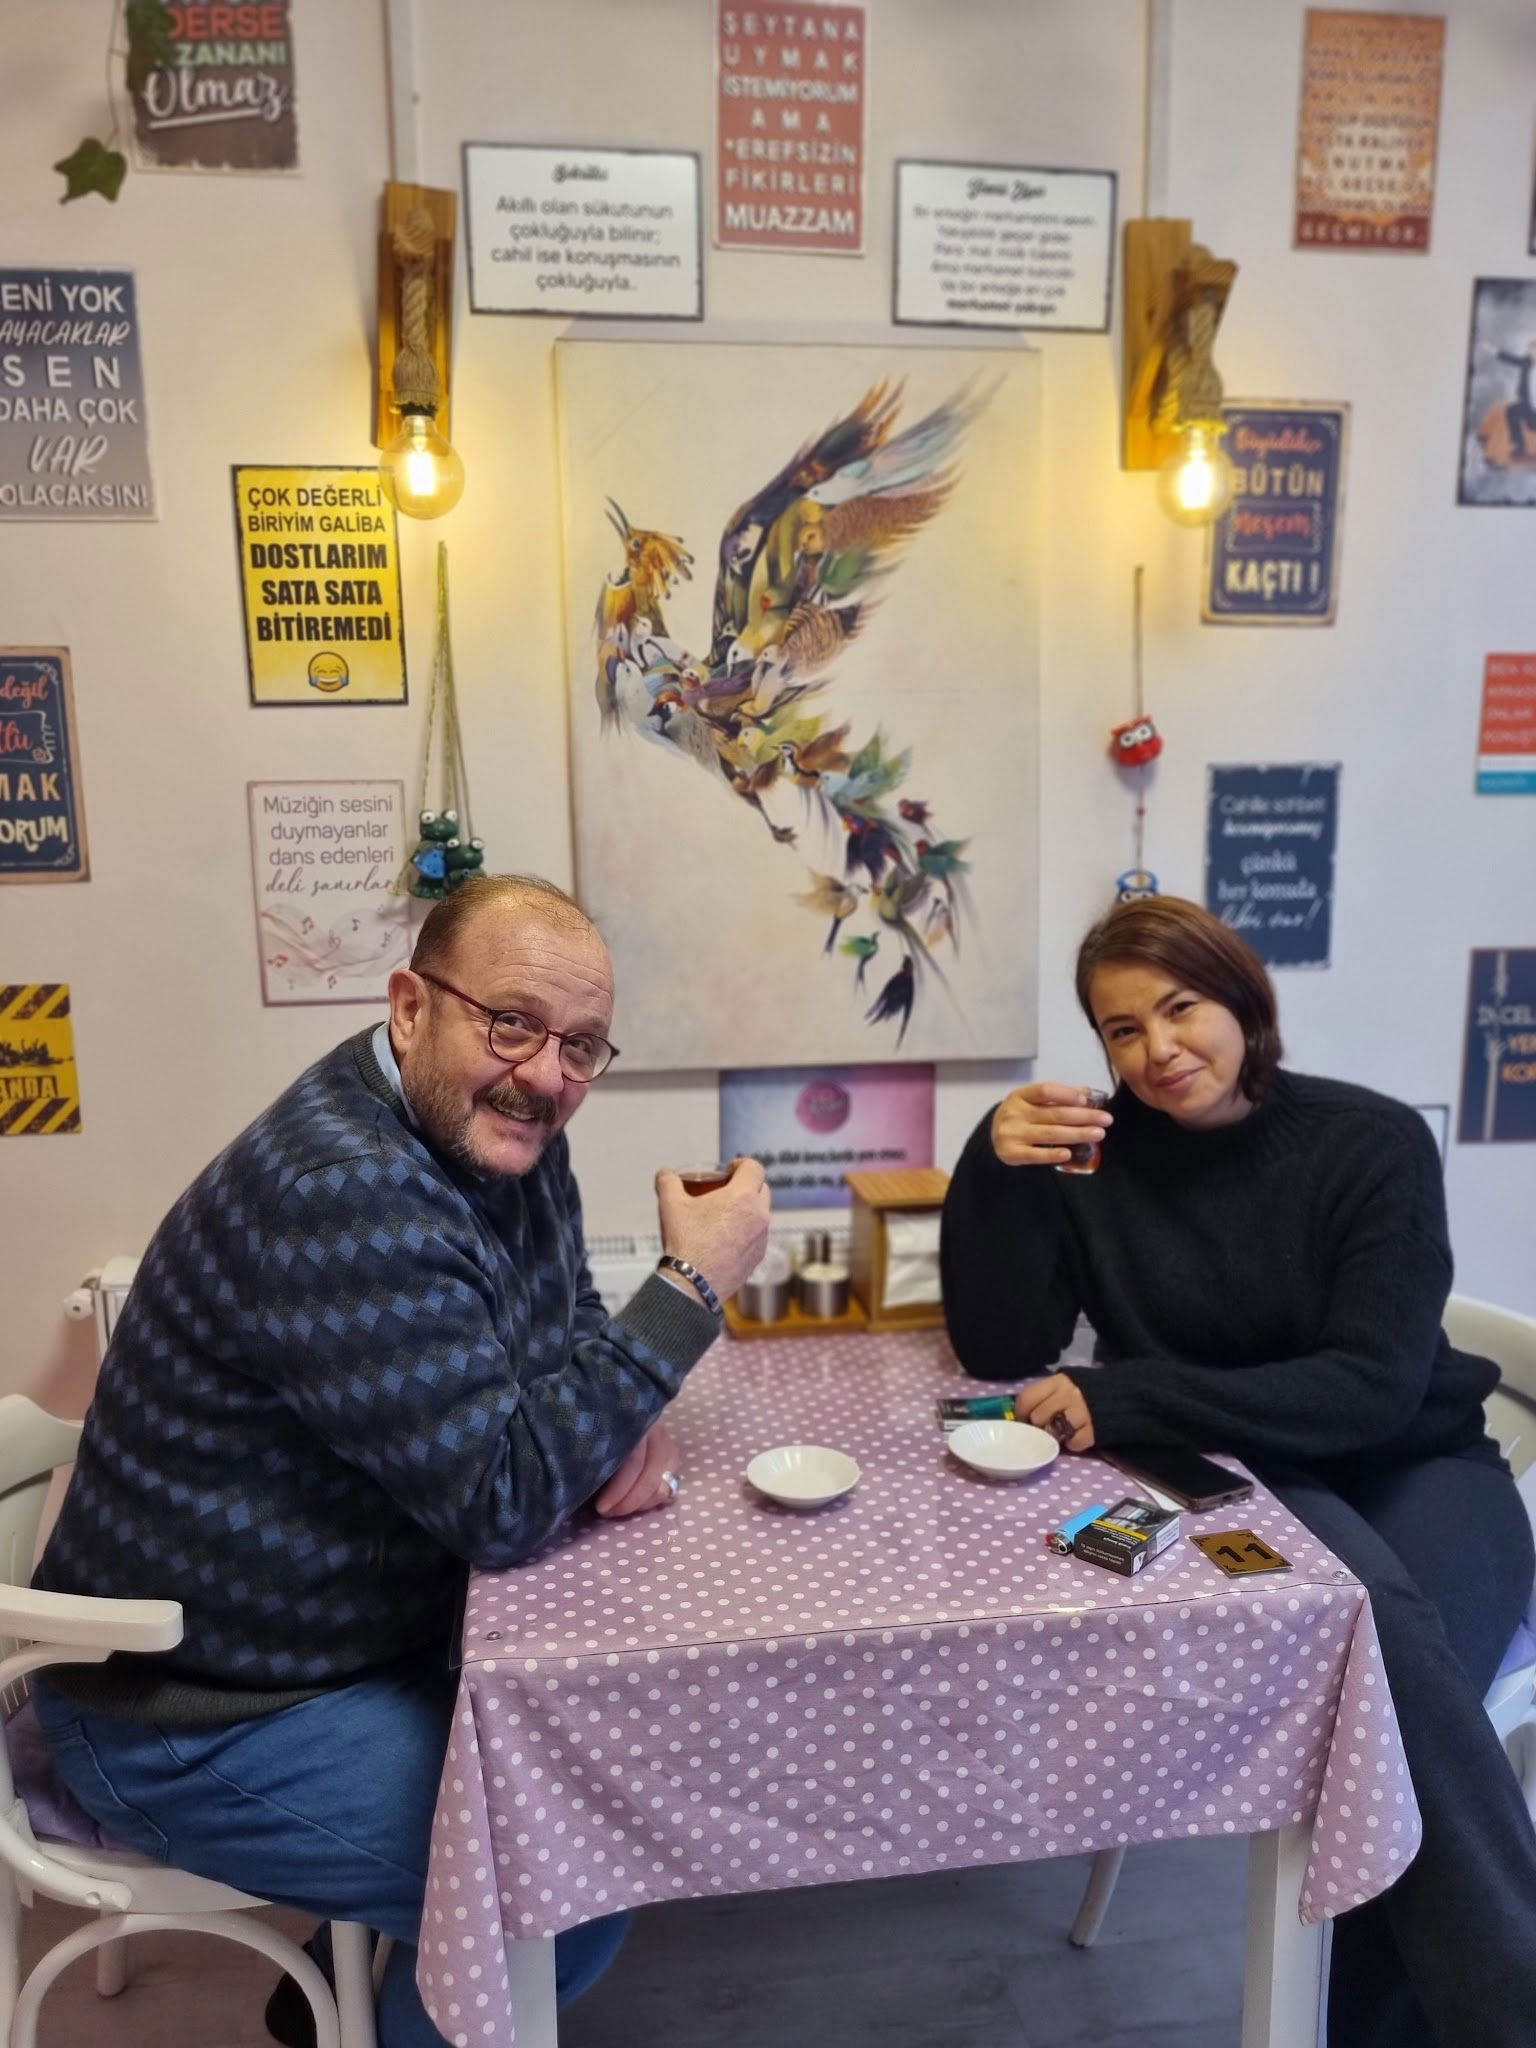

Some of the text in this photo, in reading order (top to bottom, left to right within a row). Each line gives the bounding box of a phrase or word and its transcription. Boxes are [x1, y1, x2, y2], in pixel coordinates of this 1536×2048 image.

[175, 42, 287, 66] ZANANI
[724, 202, 855, 234] MUAZZAM
[0, 277, 125, 313] ENİ YOK
[0, 319, 131, 347] AYACAKLAR
[2, 354, 121, 389] SEN
[78, 398, 138, 428] ÇOK
[29, 434, 108, 476] VAR
[248, 484, 382, 510] ÇOK DEĞERLİ
[249, 513, 386, 533] BİRİYİM GALİBA
[250, 543, 387, 569] DOSTLARIM
[262, 580, 382, 605] SATA SATA
[1226, 559, 1302, 600] KAÇTI
[256, 612, 392, 641] BİTİREMEDİ
[263, 795, 393, 818] Müziğin sesini
[0, 816, 69, 853] ORUM
[270, 820, 389, 844] duymayanlar
[269, 846, 394, 866] dans edenleri
[265, 866, 304, 892] deli
